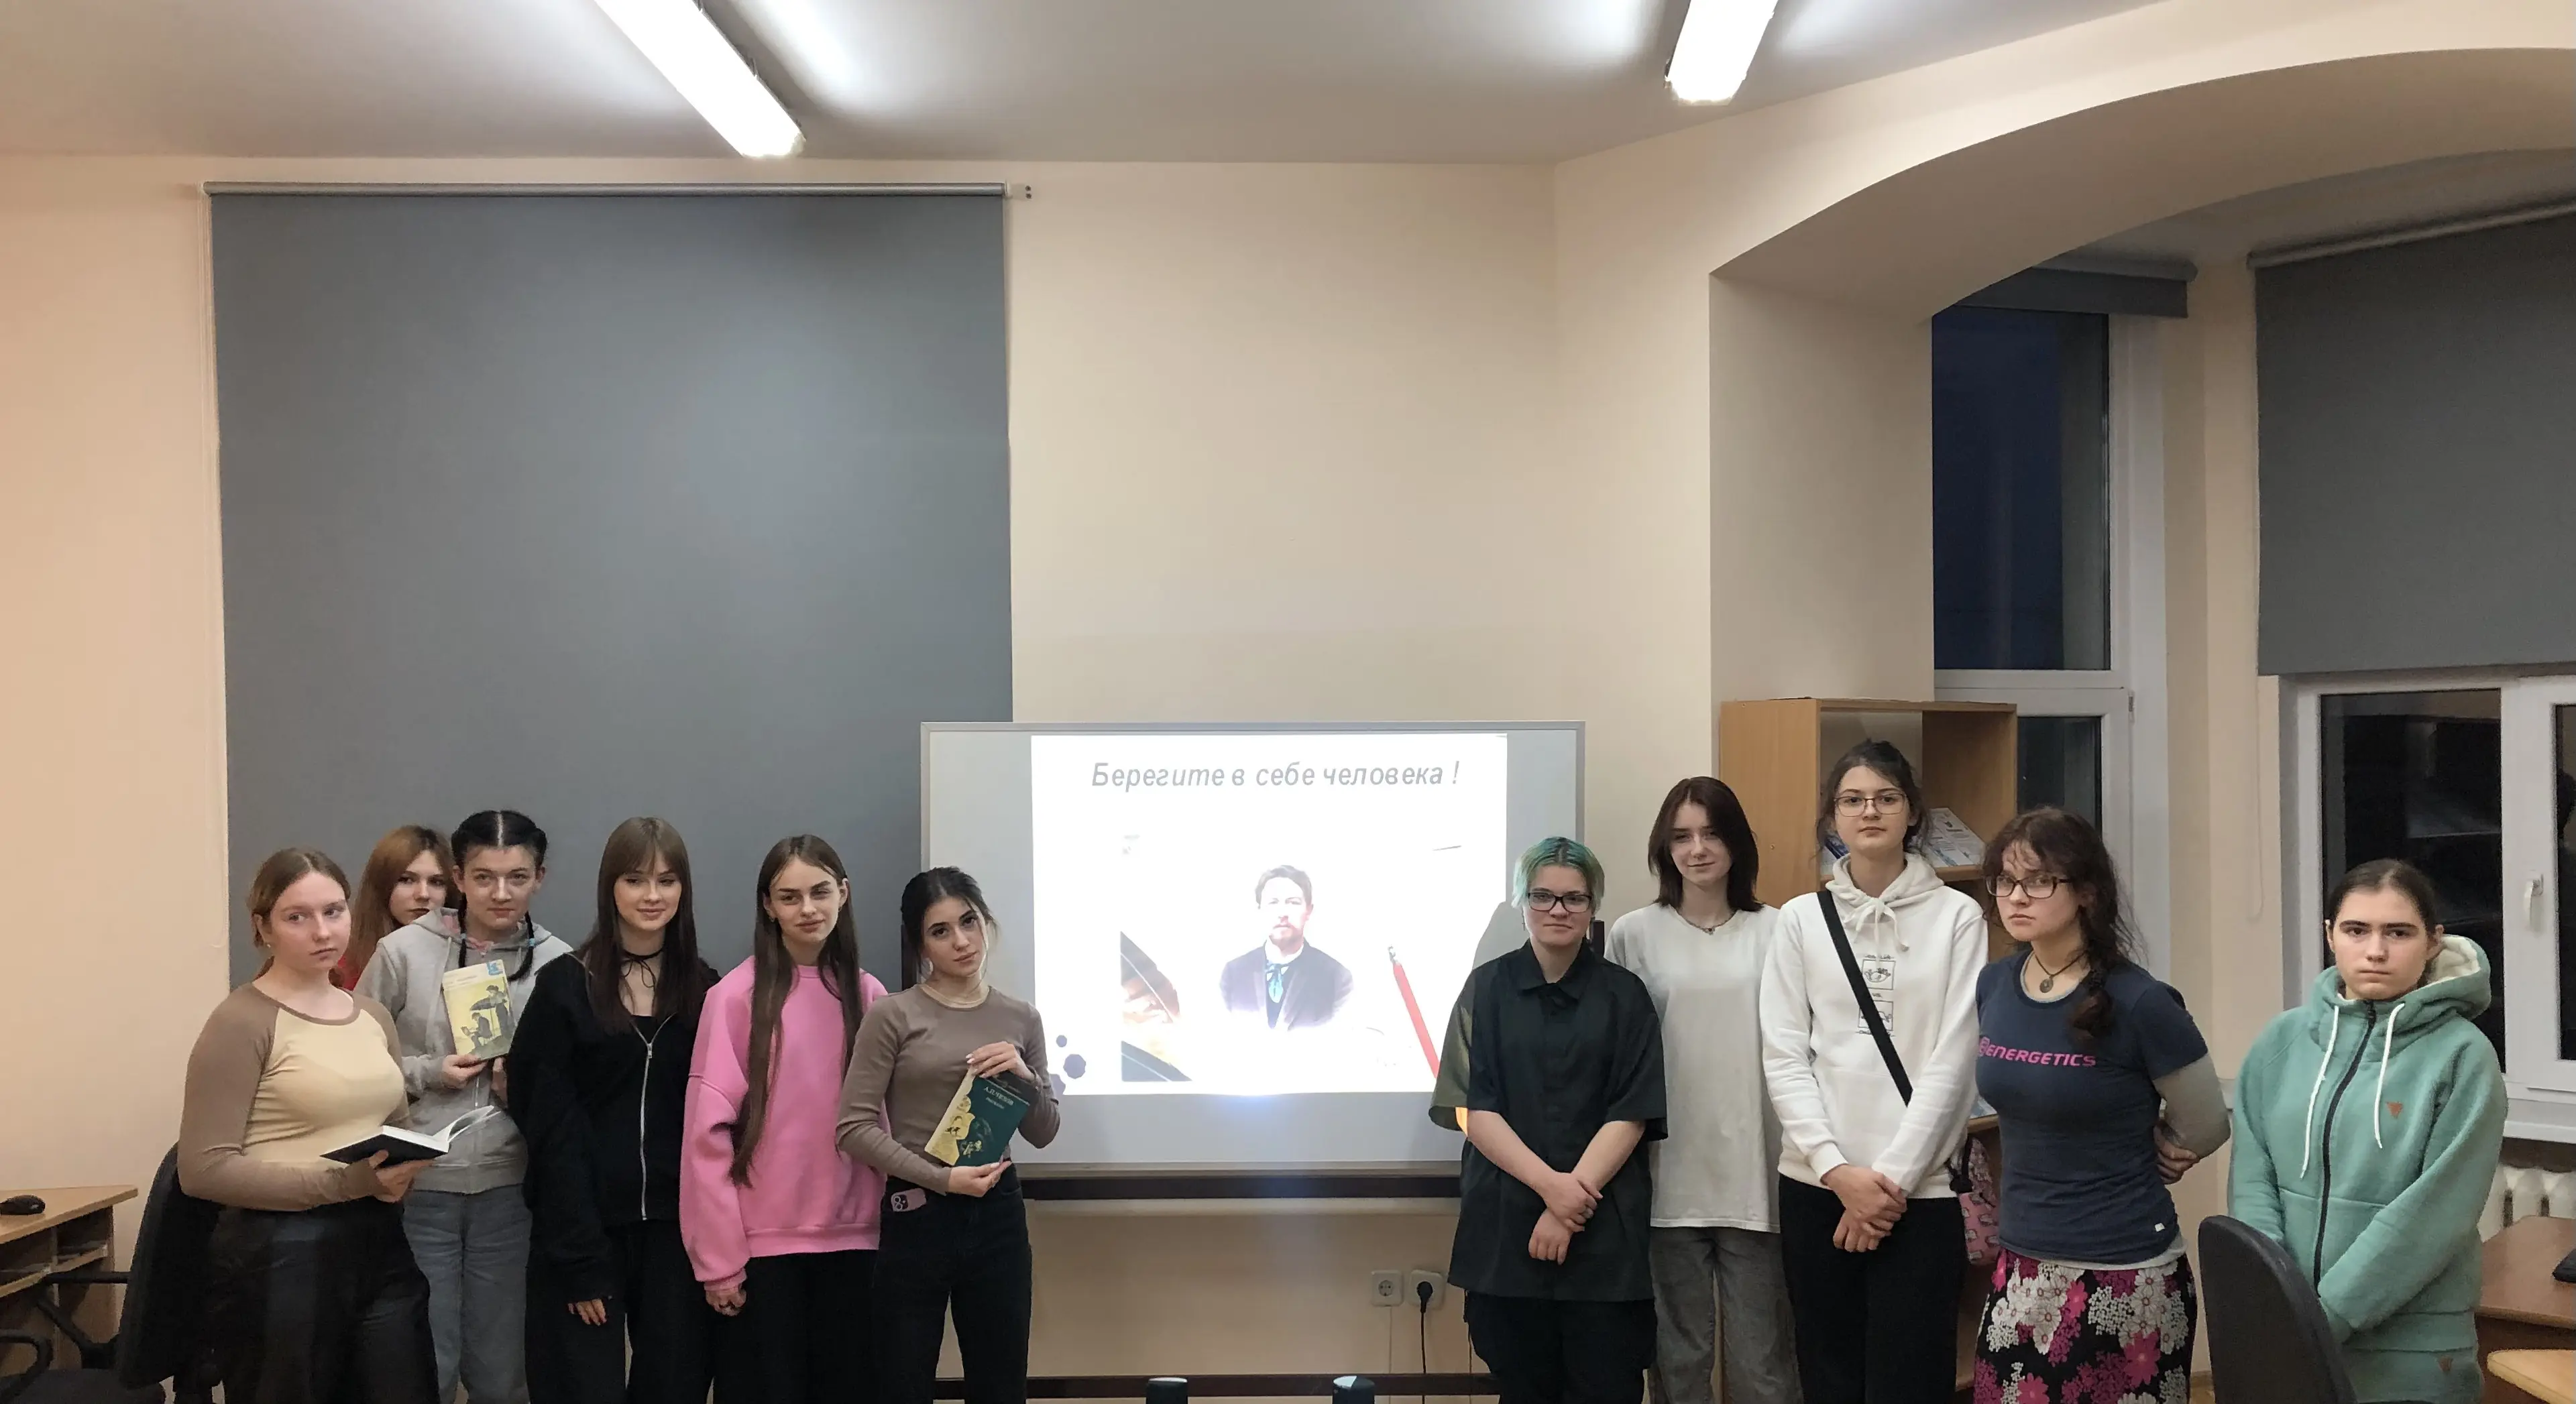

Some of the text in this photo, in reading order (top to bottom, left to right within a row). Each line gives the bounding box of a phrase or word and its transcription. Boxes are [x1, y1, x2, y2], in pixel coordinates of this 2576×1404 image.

[1092, 760, 1459, 793] Берегите в себе человека !
